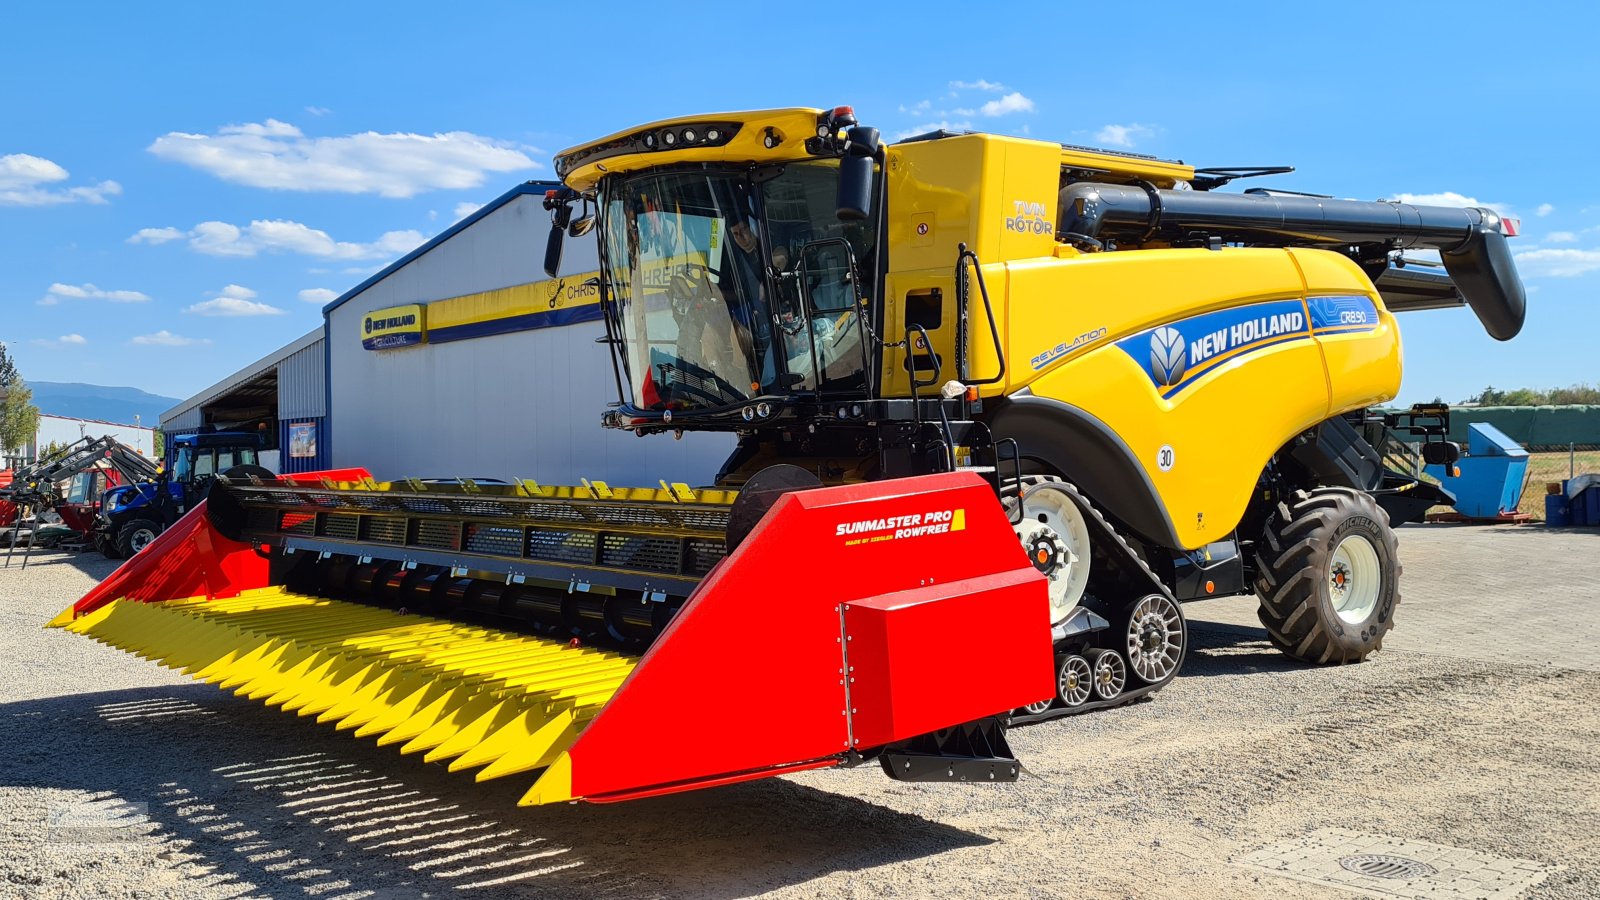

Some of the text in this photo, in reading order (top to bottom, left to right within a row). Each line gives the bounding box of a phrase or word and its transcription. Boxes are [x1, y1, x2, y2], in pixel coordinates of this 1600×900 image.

[1013, 200, 1045, 217] TWIN
[1006, 214, 1053, 235] ROTOR
[373, 314, 416, 331] NEW HOLLAND
[1030, 327, 1107, 367] REVELATION
[1191, 311, 1303, 365] NEW HOLLAND
[1160, 449, 1172, 467] 30
[835, 510, 952, 536] SUNMASTER PRO
[894, 523, 950, 540] ROWFREE
[1337, 515, 1381, 534] MICHELIN
